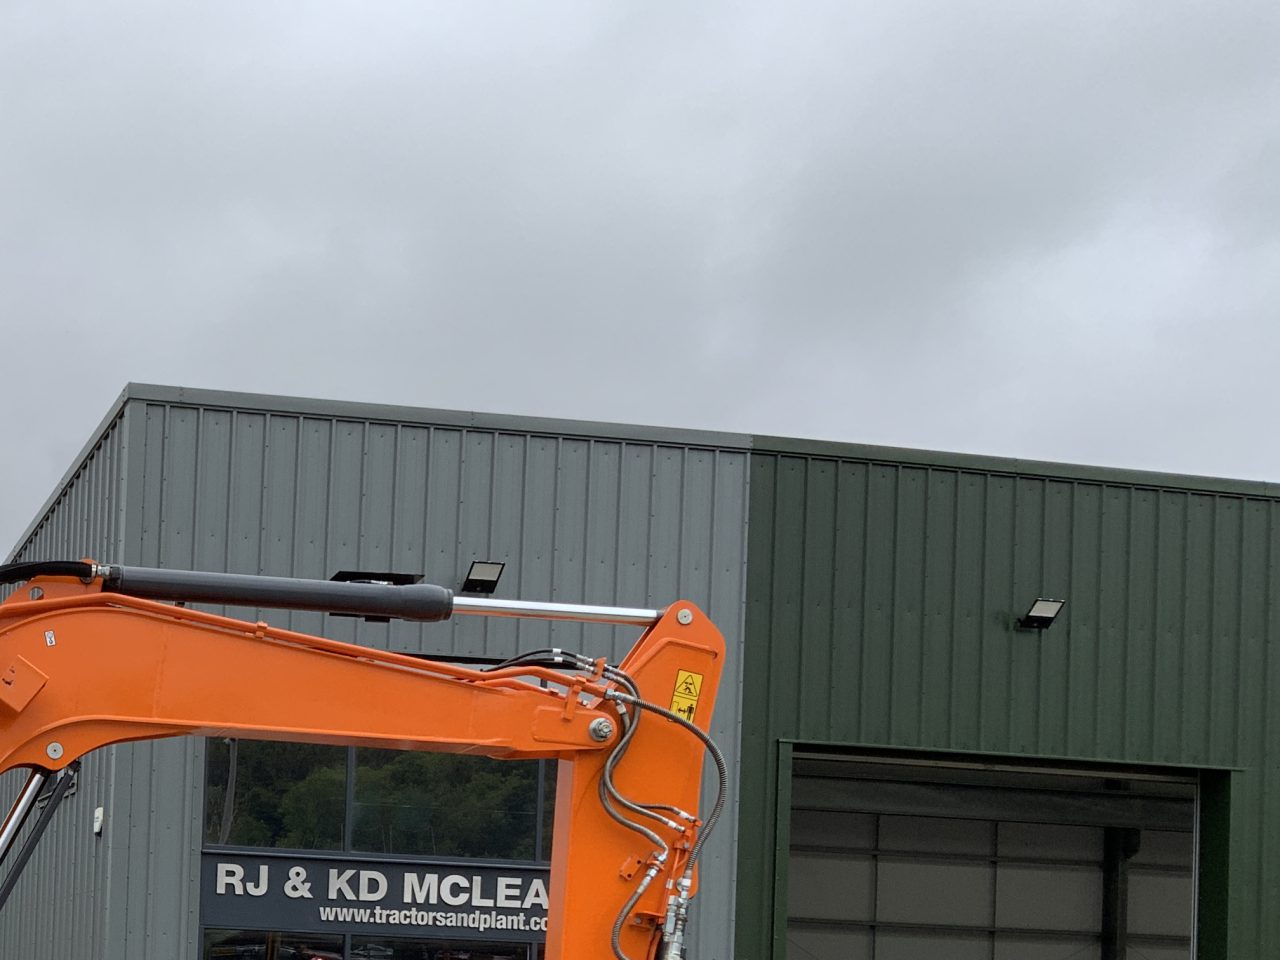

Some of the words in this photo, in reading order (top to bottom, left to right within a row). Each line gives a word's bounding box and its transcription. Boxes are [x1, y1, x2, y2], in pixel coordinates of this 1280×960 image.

[216, 863, 268, 896] RJ
[283, 866, 312, 898] &
[327, 869, 388, 902] KD
[403, 872, 549, 910] MCLEA
